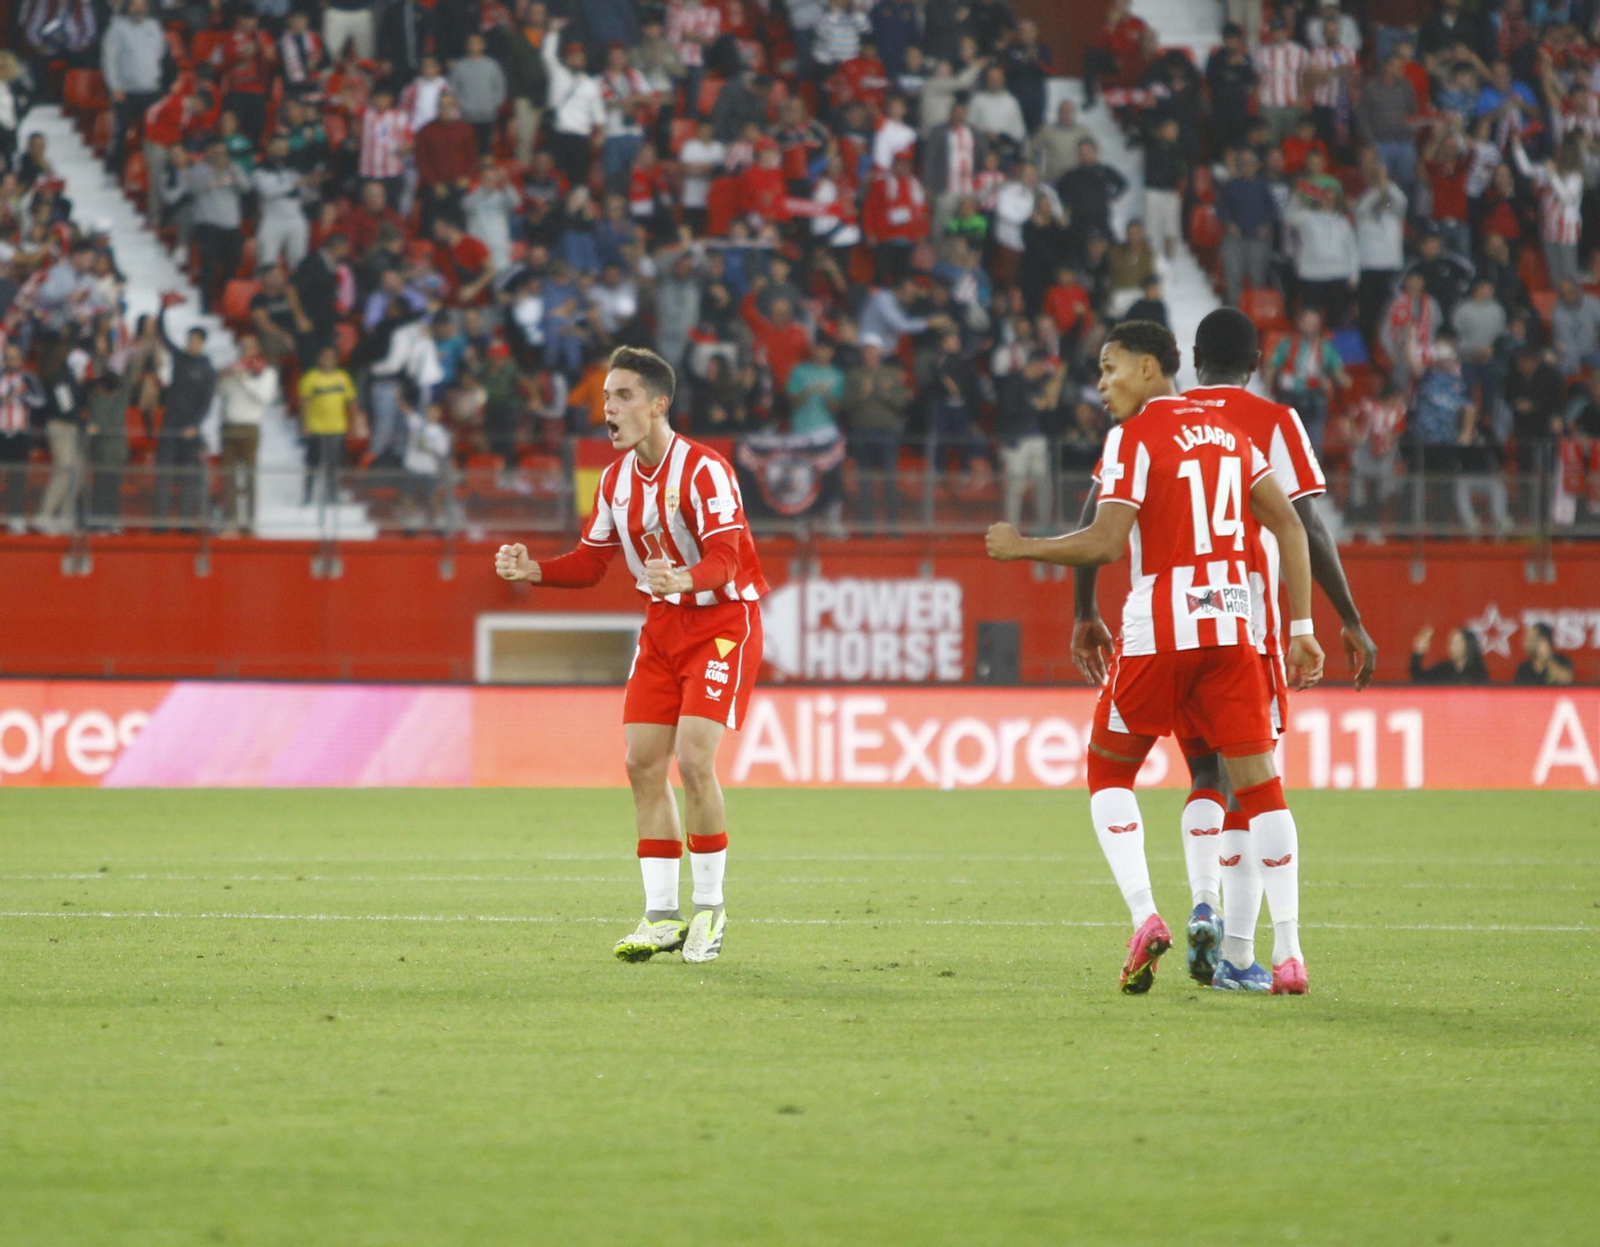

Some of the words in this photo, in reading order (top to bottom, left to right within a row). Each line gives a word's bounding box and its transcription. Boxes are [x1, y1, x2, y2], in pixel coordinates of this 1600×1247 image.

[1173, 424, 1236, 452] LÁZARO
[1177, 455, 1245, 556] 14
[805, 578, 964, 631] POWER
[704, 668, 729, 685] KUDU
[805, 631, 965, 682] HORSE
[732, 694, 1169, 789] AliExpre
